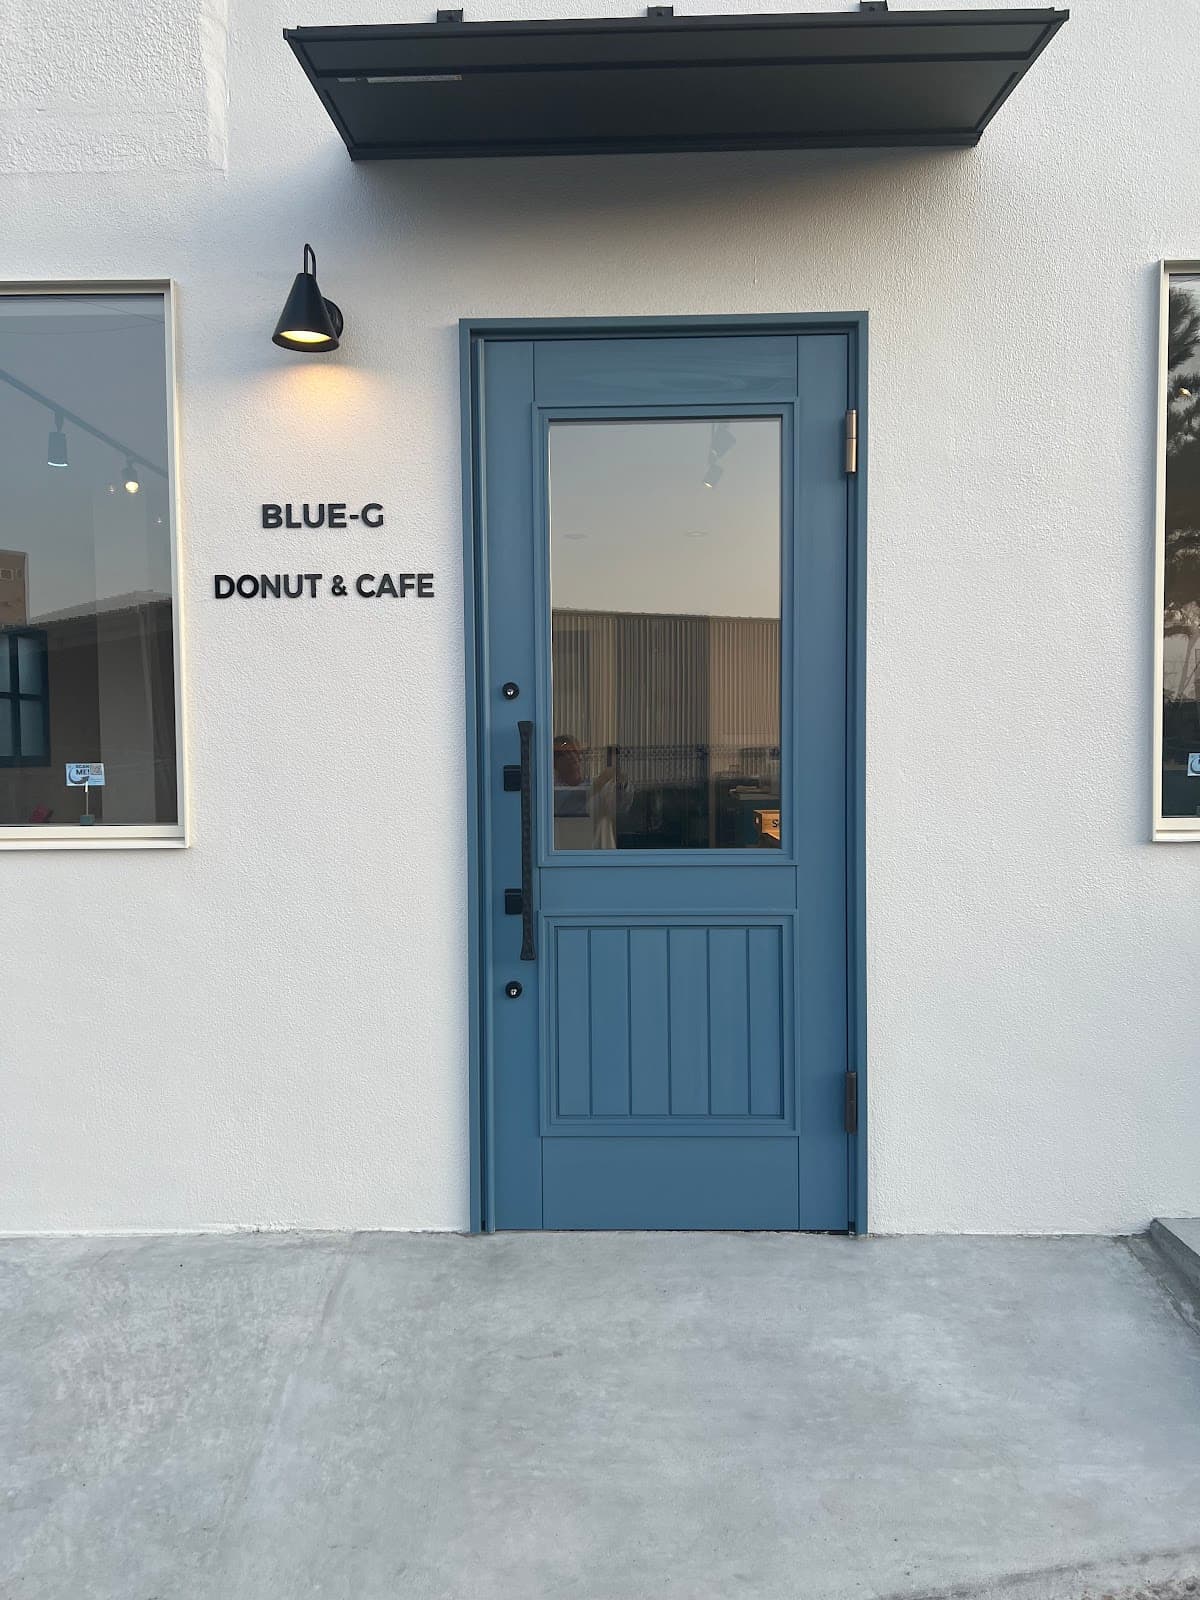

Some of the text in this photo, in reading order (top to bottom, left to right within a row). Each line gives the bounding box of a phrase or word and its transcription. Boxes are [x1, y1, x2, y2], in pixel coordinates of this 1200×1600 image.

[262, 503, 384, 528] BLUE-G
[214, 573, 435, 599] DONUT & CAFE
